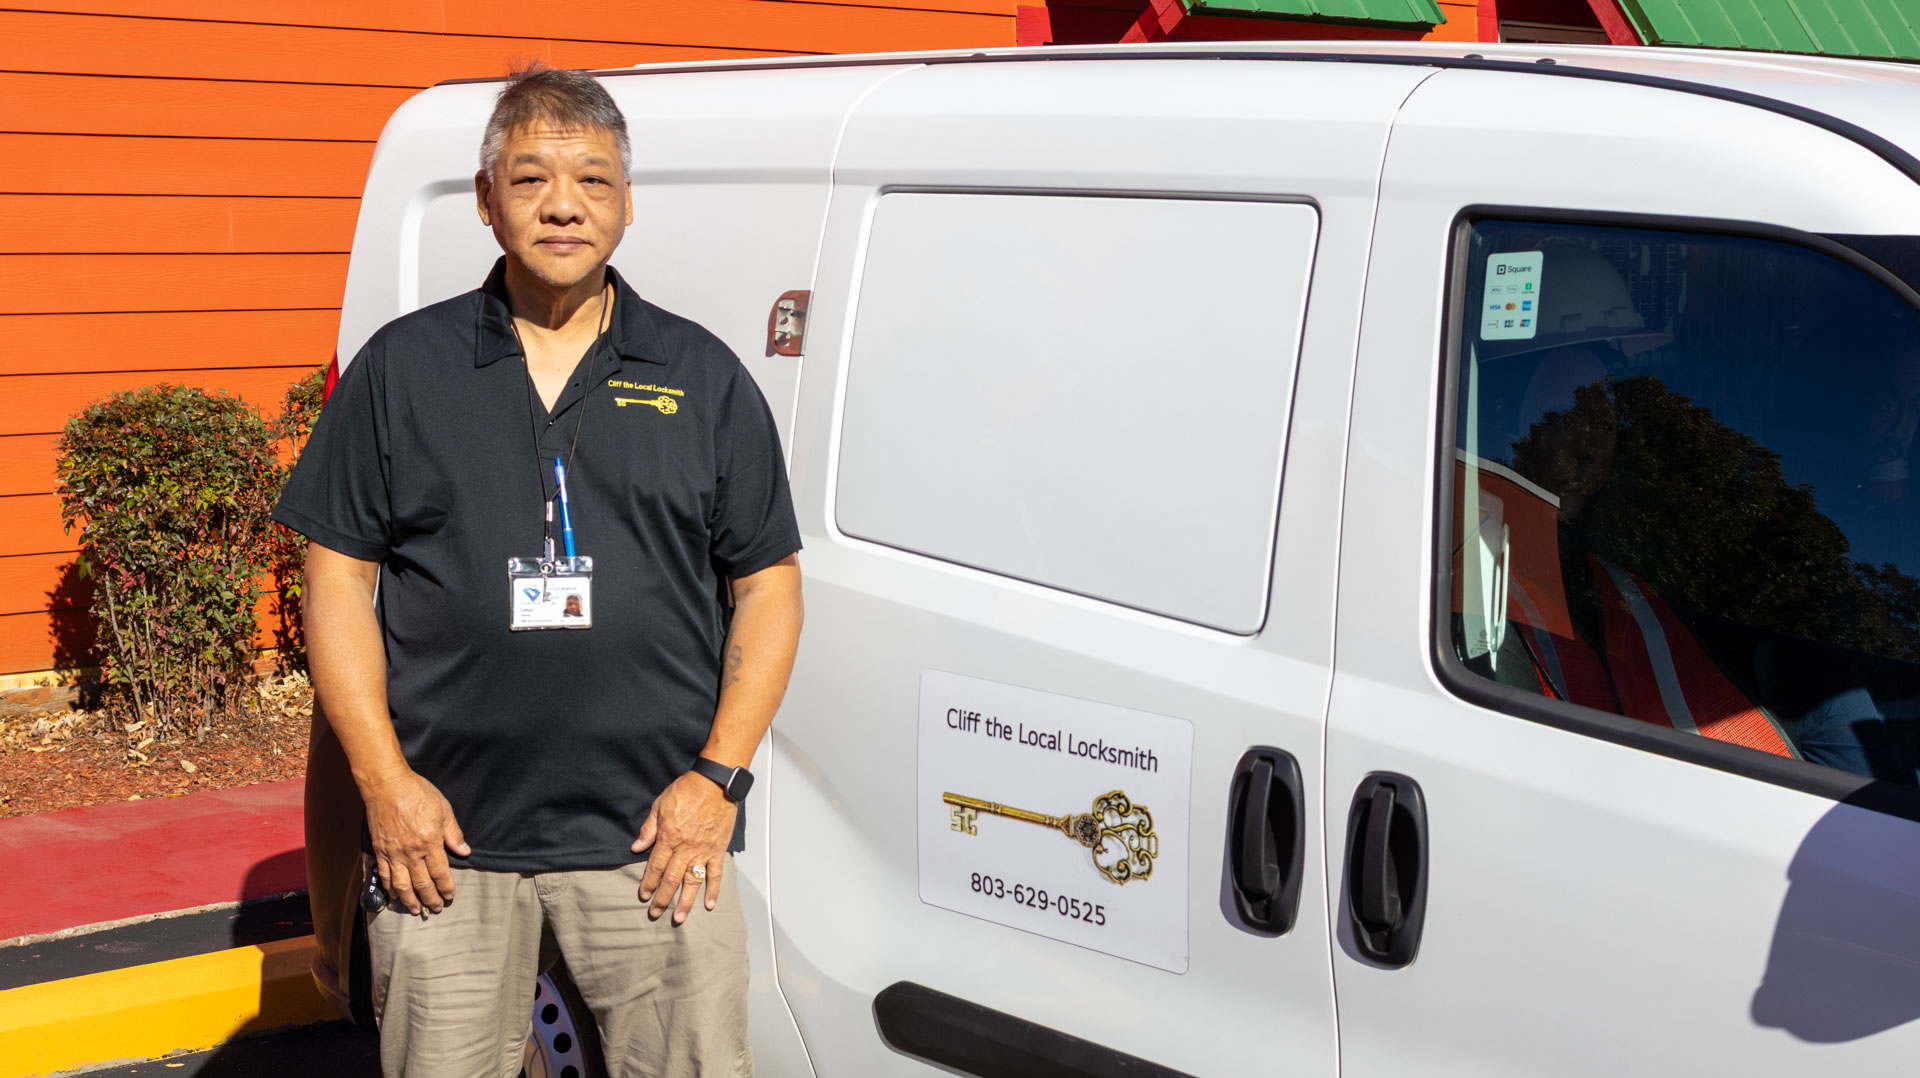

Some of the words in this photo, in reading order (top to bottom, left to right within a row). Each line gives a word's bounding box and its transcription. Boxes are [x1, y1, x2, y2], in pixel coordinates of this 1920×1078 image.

[1507, 266, 1532, 274] Square
[634, 382, 652, 391] Local
[653, 384, 685, 396] Locksmith
[946, 708, 981, 733] Cliff
[985, 717, 1013, 741] the
[1018, 723, 1062, 752] Local
[1068, 733, 1158, 773] Locksmith
[970, 872, 1106, 926] 803-629-0525
